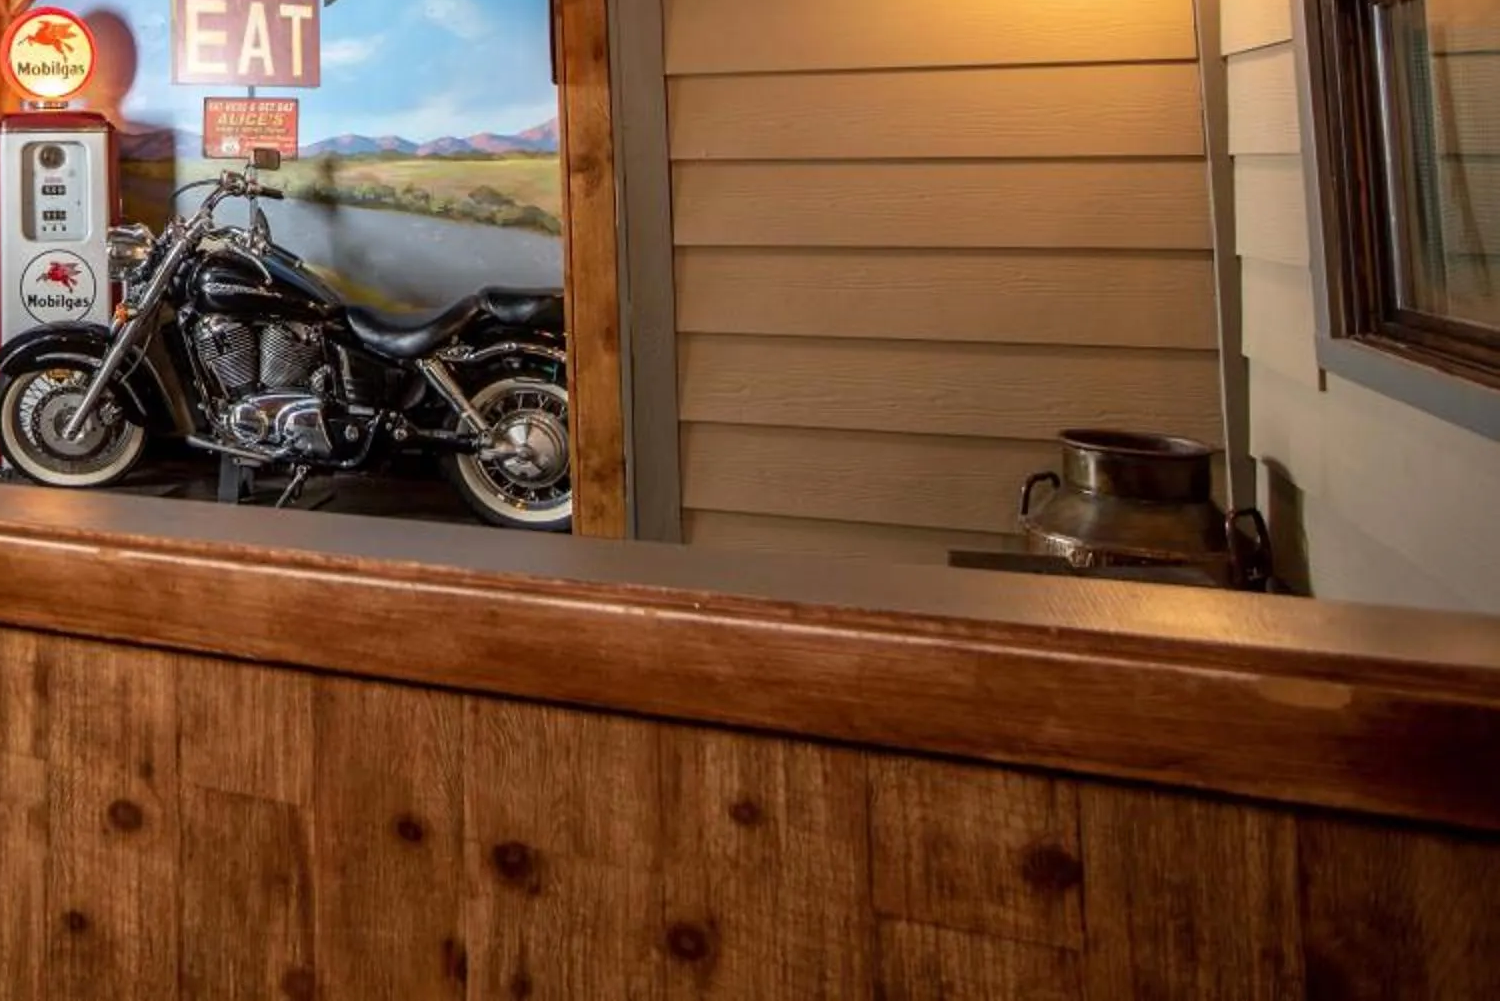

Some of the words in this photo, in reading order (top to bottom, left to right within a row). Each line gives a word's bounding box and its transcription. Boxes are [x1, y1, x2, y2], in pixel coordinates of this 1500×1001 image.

[17, 61, 85, 80] Mobilgas
[217, 112, 285, 126] ALICE'S
[27, 294, 90, 312] Mobilgas
